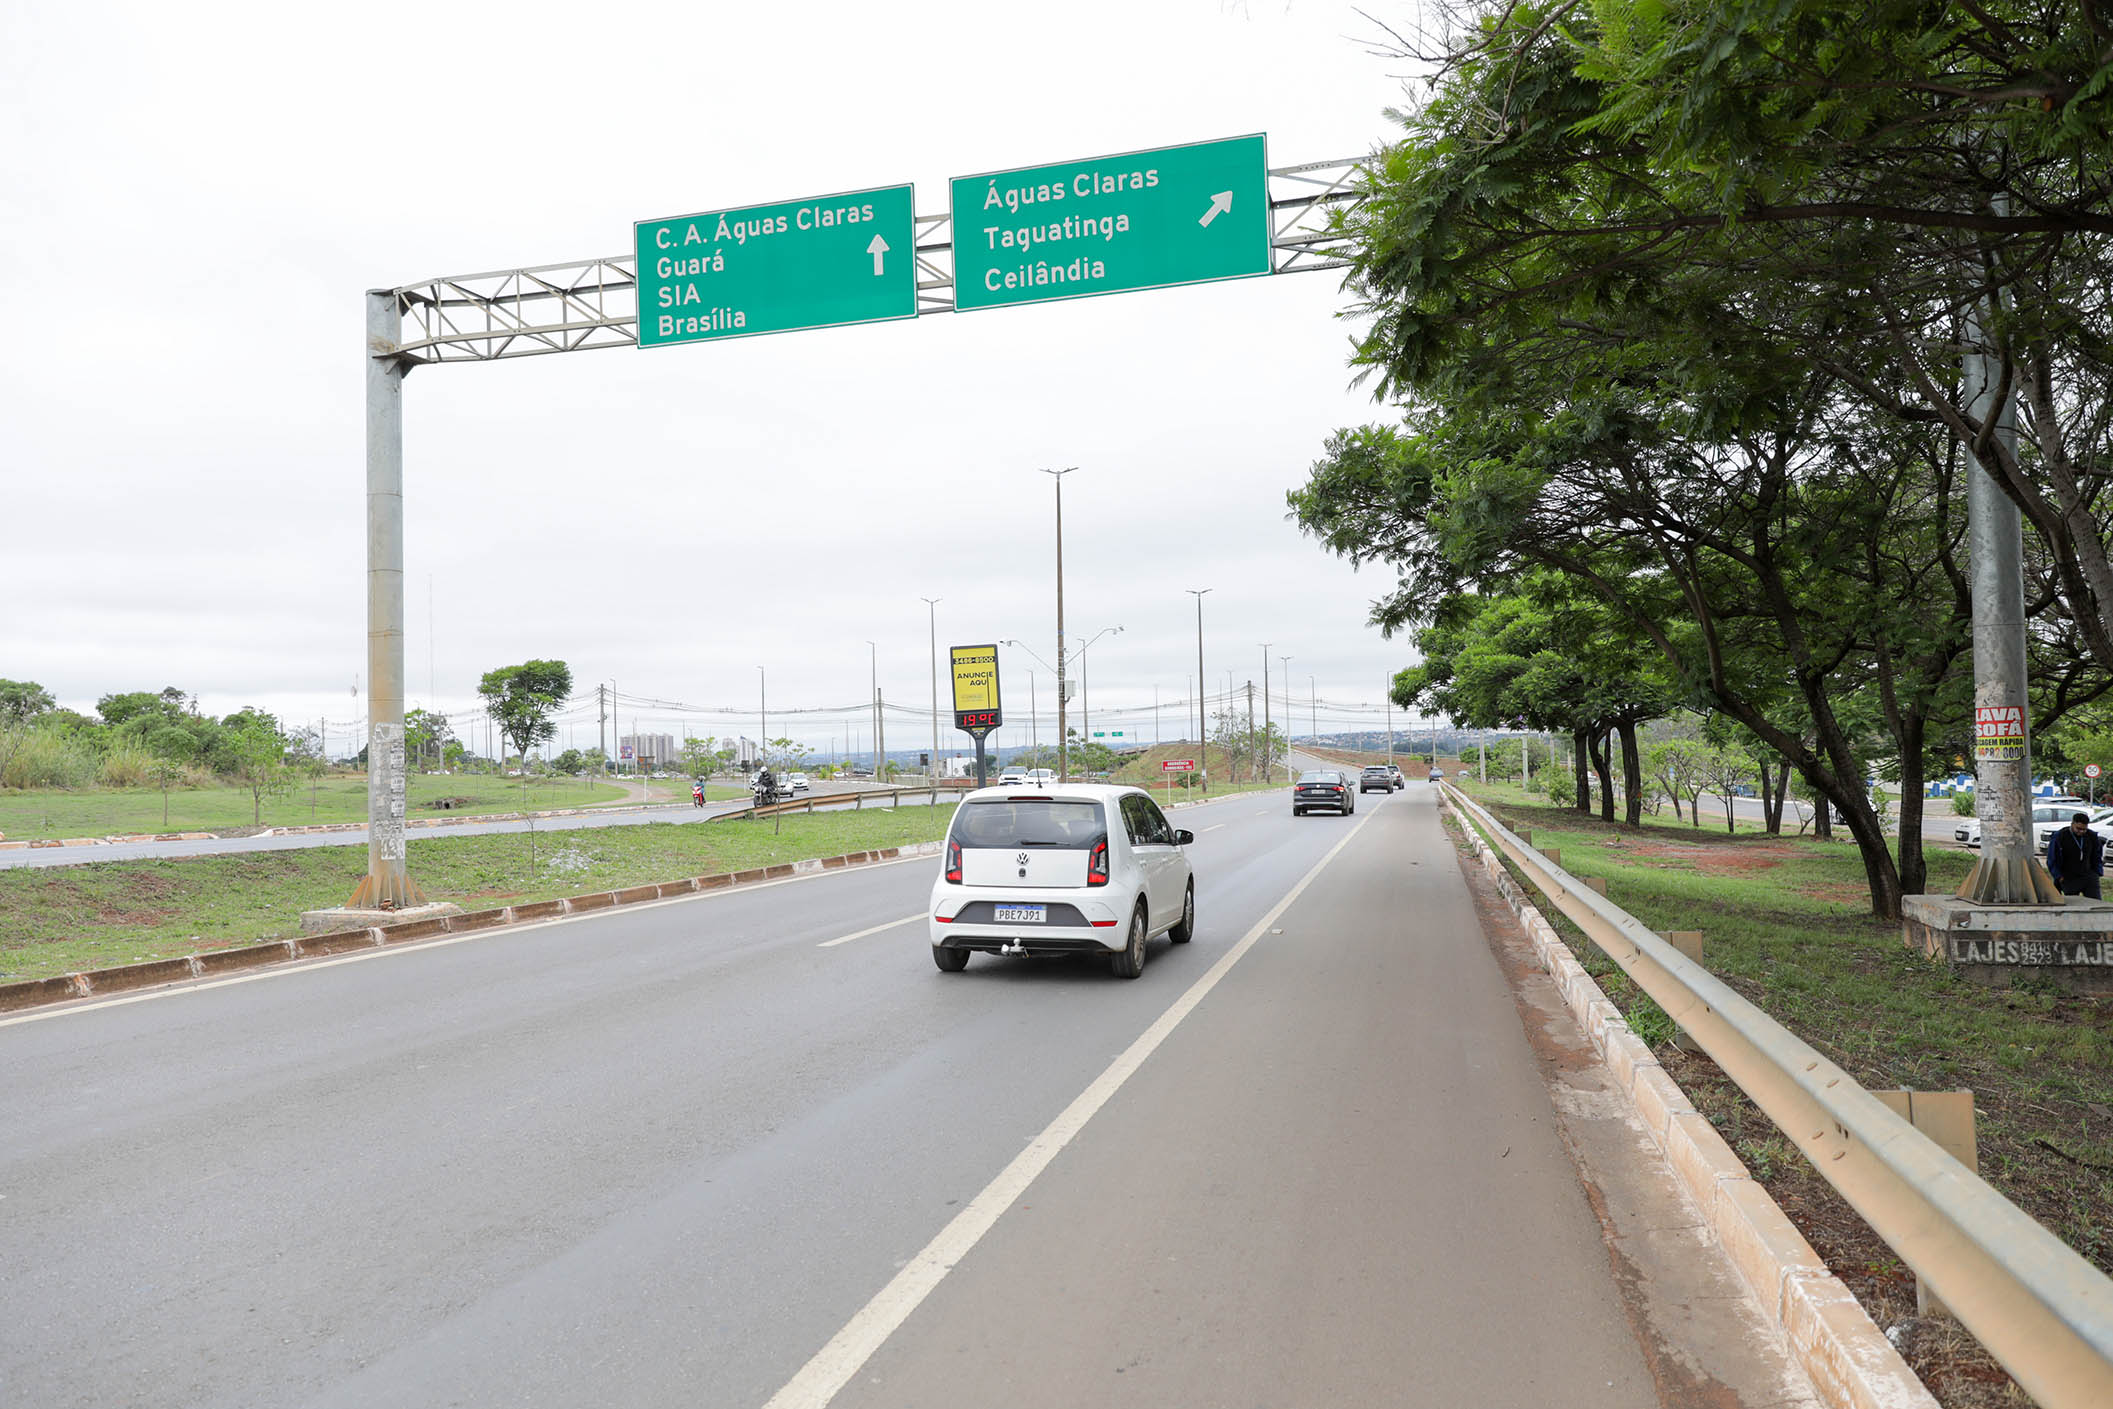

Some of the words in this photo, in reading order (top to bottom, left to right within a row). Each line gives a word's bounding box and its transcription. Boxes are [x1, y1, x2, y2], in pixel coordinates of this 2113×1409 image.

[984, 179, 1065, 214] Águas
[1073, 168, 1160, 197] Claras
[655, 228, 677, 249] C.
[683, 223, 707, 246] A.
[714, 214, 788, 245] Águas
[796, 204, 874, 231] Claras
[984, 213, 1130, 253] Taguatinga
[657, 249, 725, 278] Guará
[984, 257, 1106, 291] Ceilândia
[658, 283, 702, 308] SIA
[658, 308, 746, 336] Brasília
[957, 671, 993, 679] ANUNCIE
[1975, 707, 2021, 722] LAVA
[1975, 720, 2023, 736] SOFÁ
[999, 910, 1040, 920] PBE7J91
[1951, 940, 2019, 964] LAJES
